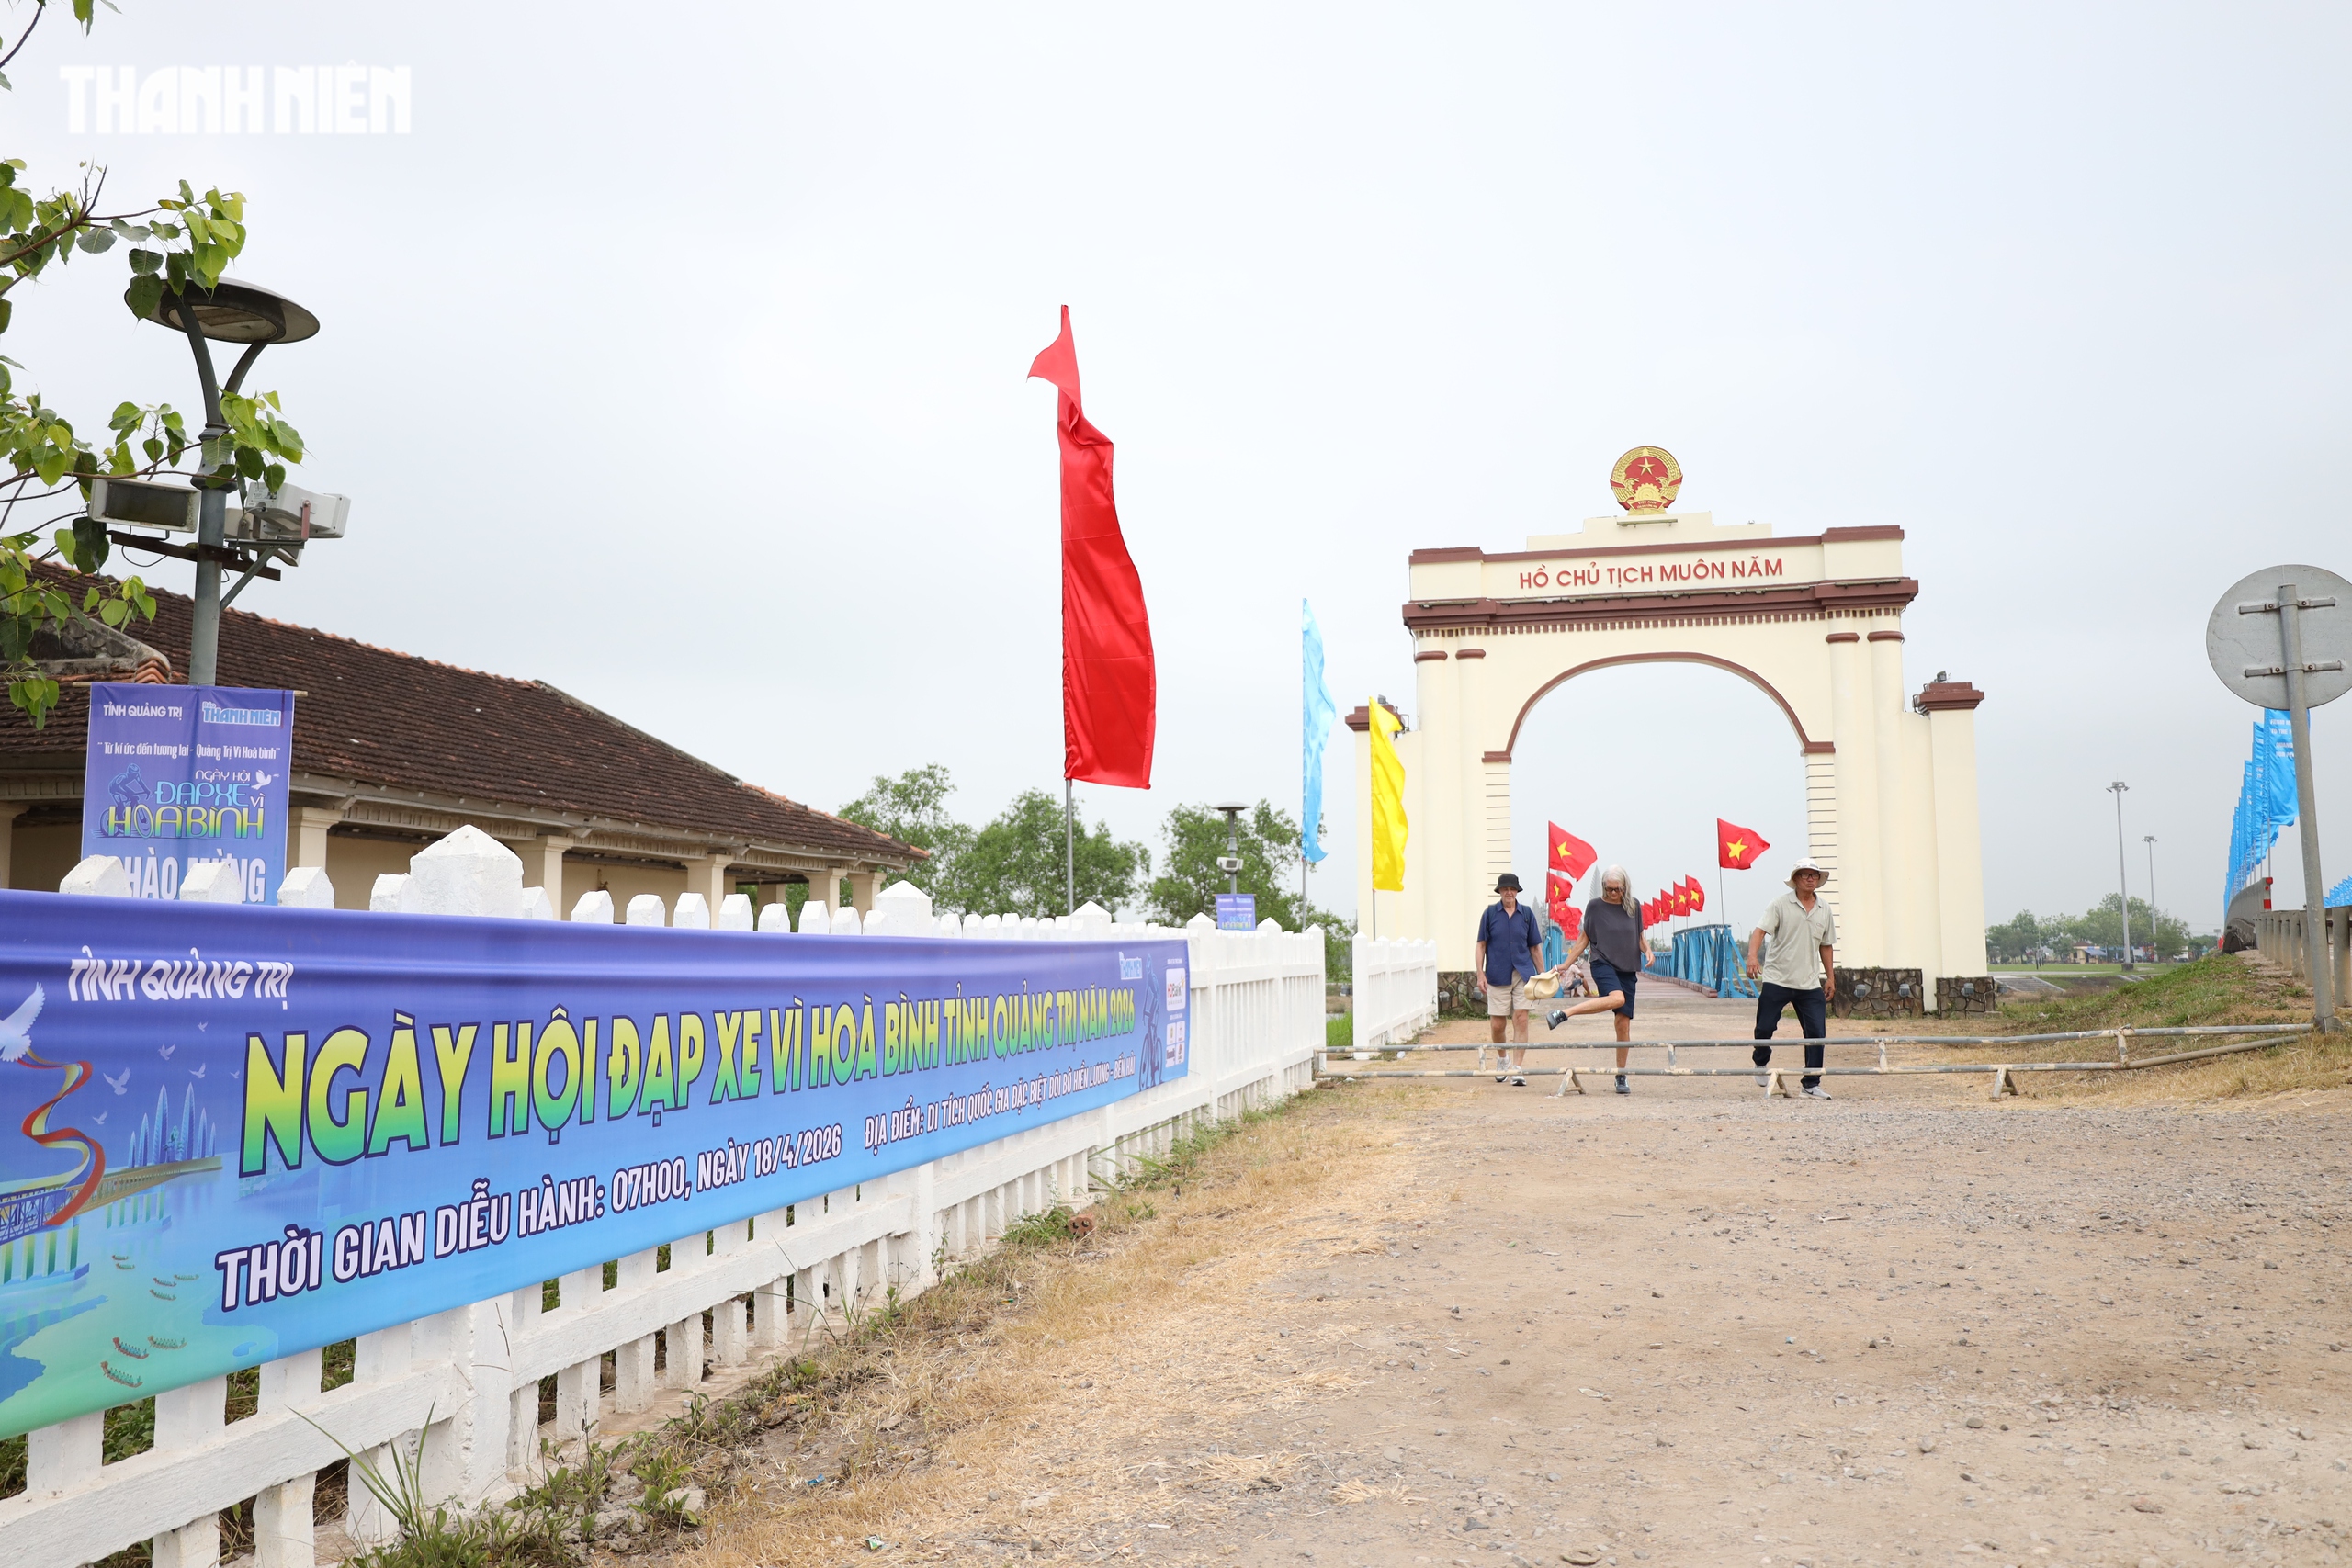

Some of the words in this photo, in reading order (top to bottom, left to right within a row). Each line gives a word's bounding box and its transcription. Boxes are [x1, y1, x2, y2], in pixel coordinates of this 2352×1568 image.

[1519, 563, 1549, 589] HỒ
[1556, 561, 1600, 587] CHỦ
[1607, 565, 1653, 588] TỊCH
[1659, 558, 1725, 582] MUÔN
[1731, 555, 1783, 578] NĂM
[103, 701, 127, 716] TỈNH
[128, 702, 166, 717] QUẢNG
[168, 705, 183, 720] TRỊ
[201, 706, 249, 725] THANH
[249, 708, 281, 726] NIÊN
[114, 741, 123, 754] kí
[123, 742, 135, 755] ức
[137, 742, 152, 755] đến
[153, 743, 177, 760] tương
[178, 743, 189, 757] lai
[196, 743, 220, 761] Quảng
[222, 745, 232, 760] Trị
[233, 745, 243, 758] Vì
[243, 746, 257, 759] Hoà
[195, 770, 230, 783] NGÀY
[232, 770, 251, 784] HỘI
[250, 793, 266, 807] VÌ
[187, 806, 265, 839] BÌNH
[122, 847, 178, 900] HÀO
[68, 944, 141, 1002] TỈNH
[141, 947, 254, 1001] QUẢNG
[254, 961, 294, 1010] TRỊ
[239, 1008, 481, 1178] NGÀY
[488, 1002, 599, 1145] HỘI
[606, 1012, 706, 1127] ĐẠP
[709, 1008, 762, 1105] XE
[769, 995, 803, 1095] VÌ
[808, 991, 877, 1089] HOÀ
[882, 990, 940, 1077] BÌNH
[944, 981, 989, 1066] TỈNH
[992, 979, 1054, 1061] QUẢNG
[1057, 988, 1077, 1051] TRỊ
[1079, 982, 1108, 1043] NĂM
[1110, 987, 1136, 1038] 2026
[864, 1114, 888, 1156] ĐỊA
[890, 1095, 924, 1144] ĐIỂM:
[927, 1104, 940, 1134] DI
[941, 1091, 966, 1130] TÍCH
[967, 1081, 993, 1125] QUỐC
[994, 1086, 1010, 1115] GIA
[1011, 1077, 1029, 1116] ĐẶC
[1029, 1072, 1048, 1110] BIỆT
[1048, 1068, 1063, 1100] ĐÔI
[1062, 1066, 1073, 1096] BỜ
[1073, 1059, 1089, 1093] HIỀN
[1089, 1061, 1110, 1088] LƯƠNG
[1114, 1051, 1125, 1081] BẾN
[1125, 1049, 1136, 1077] HẢI
[215, 1223, 324, 1311] THỜI
[333, 1209, 426, 1283] GIAN
[434, 1177, 511, 1258] DIỄU
[517, 1173, 605, 1239] HÀNH:
[611, 1156, 692, 1214] 07H00,
[696, 1137, 750, 1193] NGÀY
[753, 1123, 842, 1178] 18/4/2026
